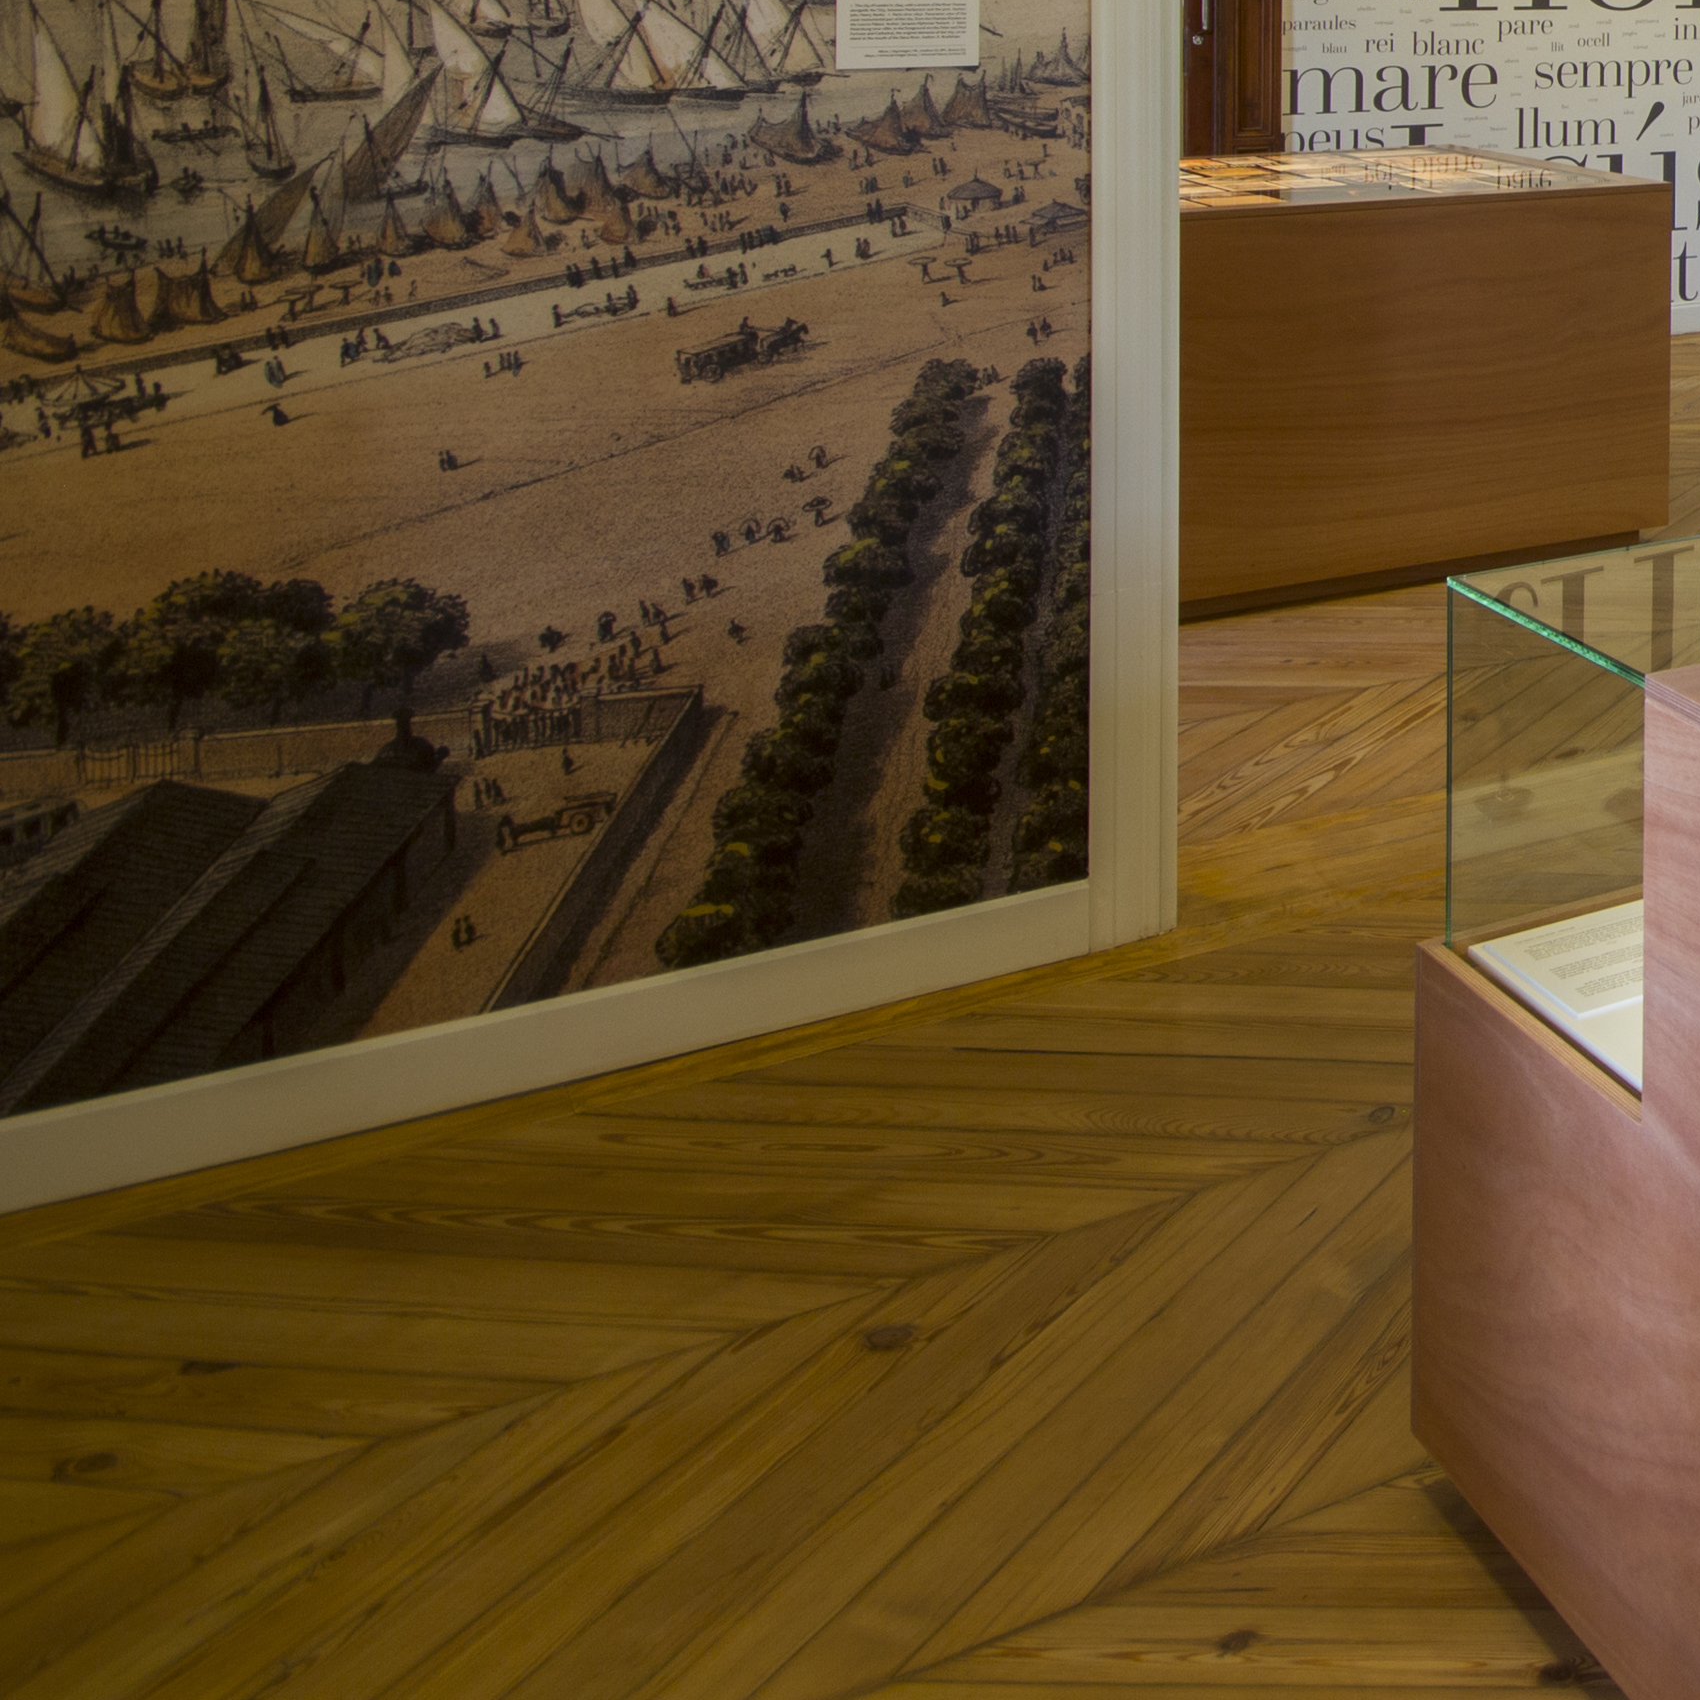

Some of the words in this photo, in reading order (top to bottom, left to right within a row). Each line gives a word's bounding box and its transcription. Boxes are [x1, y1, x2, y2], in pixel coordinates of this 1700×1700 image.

[1282, 15, 1357, 35] paraules
[1497, 19, 1553, 42] pare
[1322, 43, 1347, 54] blau
[1365, 32, 1395, 53] rei
[1411, 31, 1485, 56] blanc
[1551, 41, 1564, 52] llit
[1577, 32, 1610, 47] ocell
[1282, 63, 1498, 116] mare
[1534, 57, 1693, 99] sempre
[1514, 107, 1619, 149] llum
